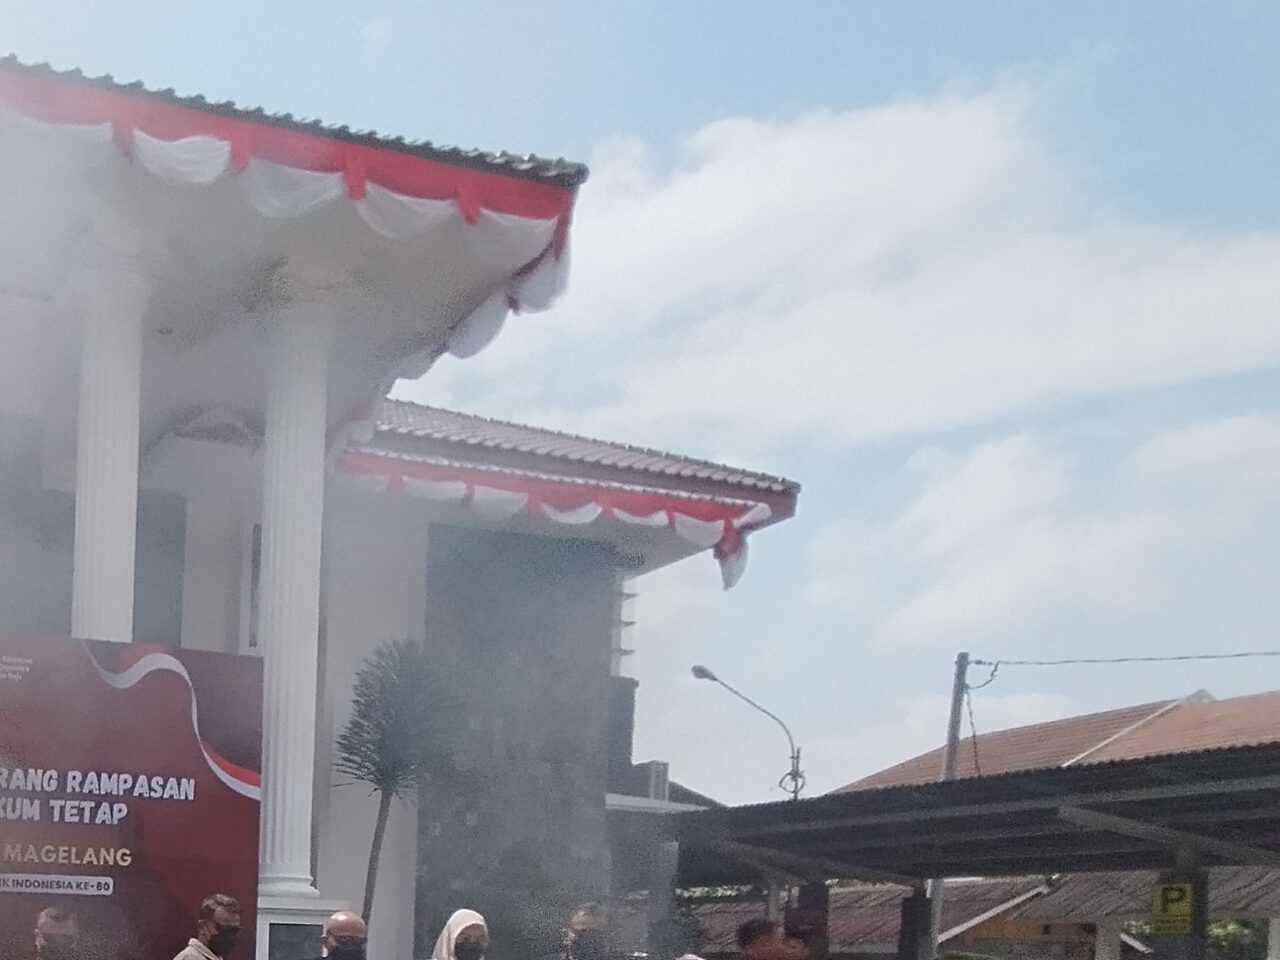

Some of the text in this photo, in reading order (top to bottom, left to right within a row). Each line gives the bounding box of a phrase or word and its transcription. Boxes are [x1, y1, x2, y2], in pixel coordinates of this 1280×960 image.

[66, 769, 196, 801] RAMPASAN
[49, 799, 128, 825] TETAP
[4, 843, 132, 867] MAGELANG
[12, 878, 74, 890] INDONESIA
[1161, 887, 1187, 912] P
